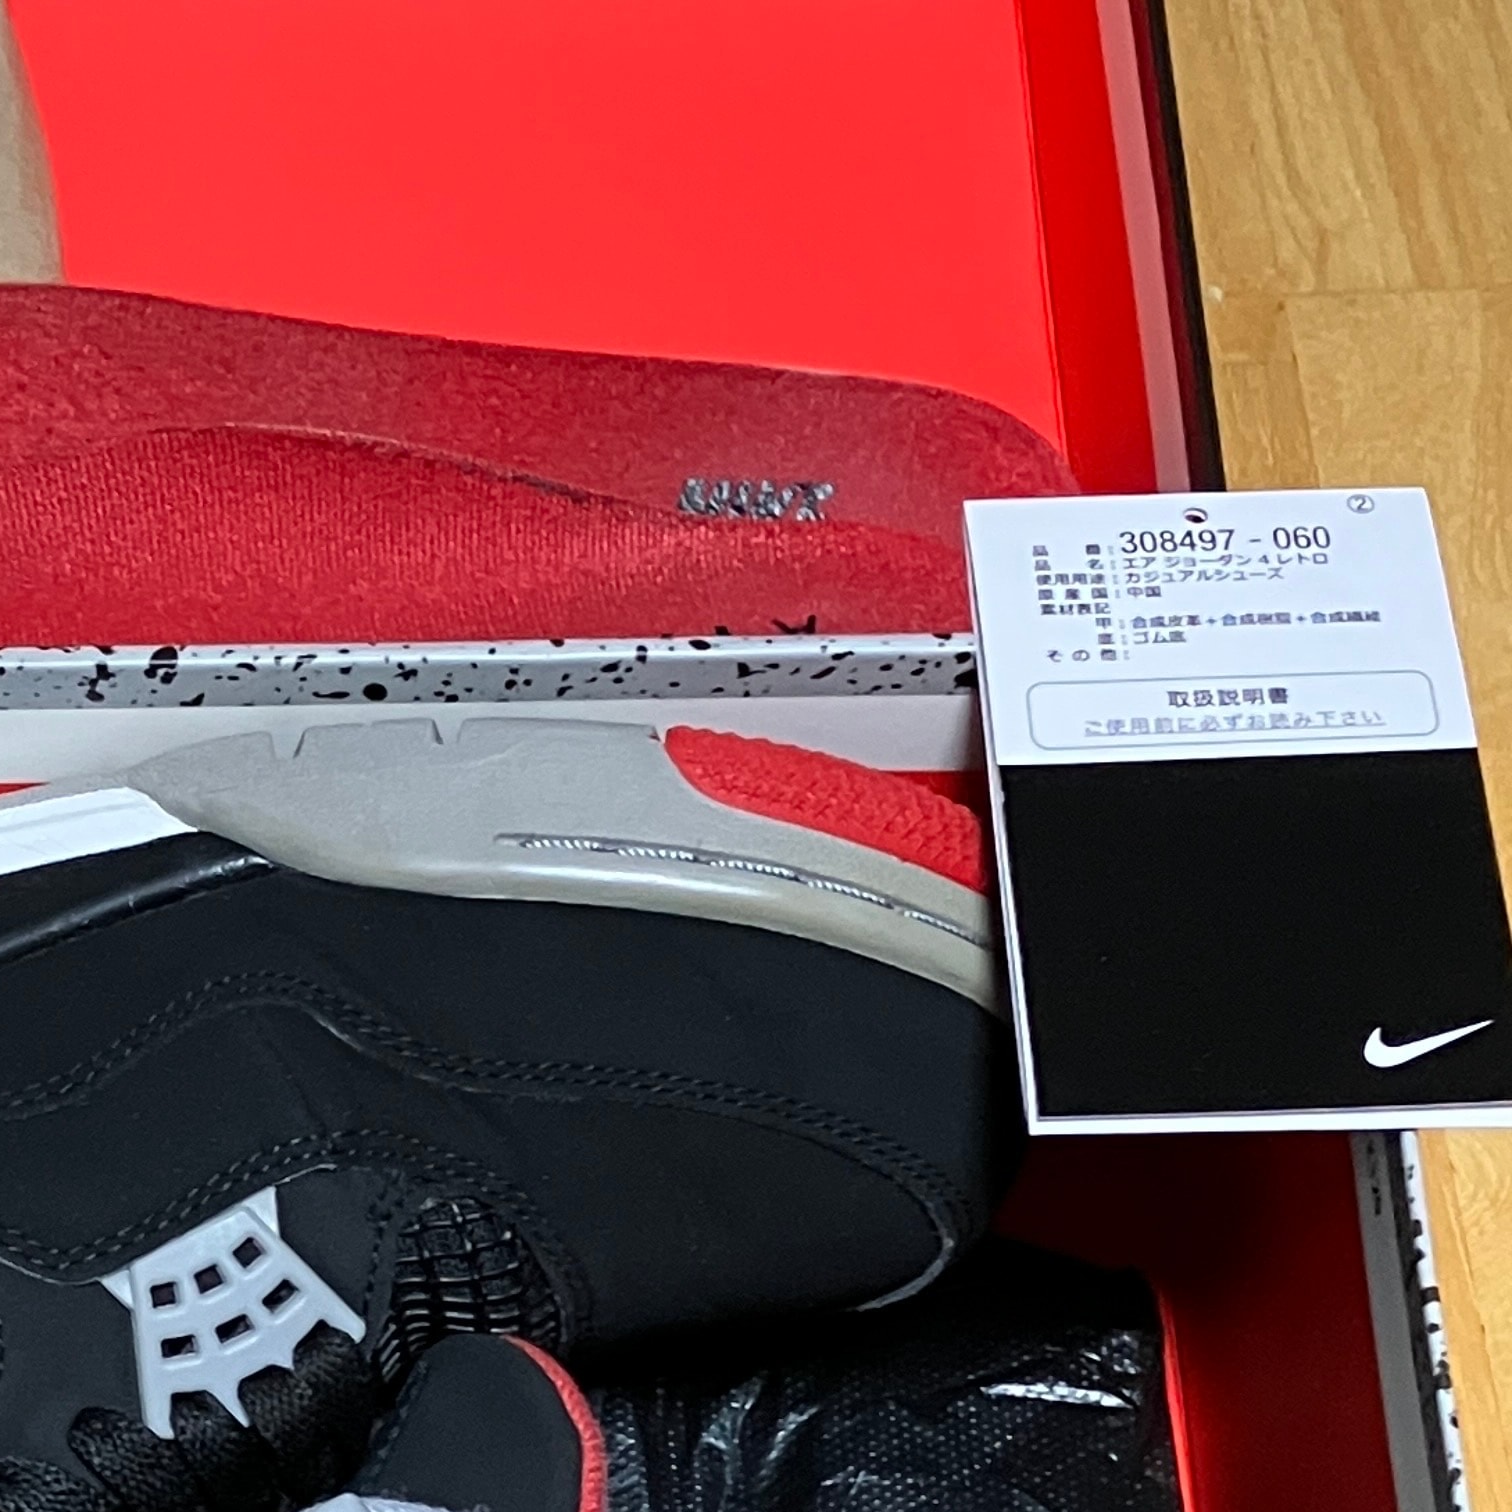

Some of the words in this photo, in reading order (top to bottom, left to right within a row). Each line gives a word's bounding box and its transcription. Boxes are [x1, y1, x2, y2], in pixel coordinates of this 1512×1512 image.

[1119, 529, 1235, 553] 308497
[1273, 526, 1331, 549] 060
[1258, 554, 1270, 564] 4
[1277, 552, 1329, 565] レトロ
[1125, 567, 1285, 583] カジュアルシューズ
[1127, 586, 1162, 598] 中国
[1167, 687, 1289, 708] 取扱説明書
[1084, 710, 1386, 737] ご使用前に必ずお読み下さい
